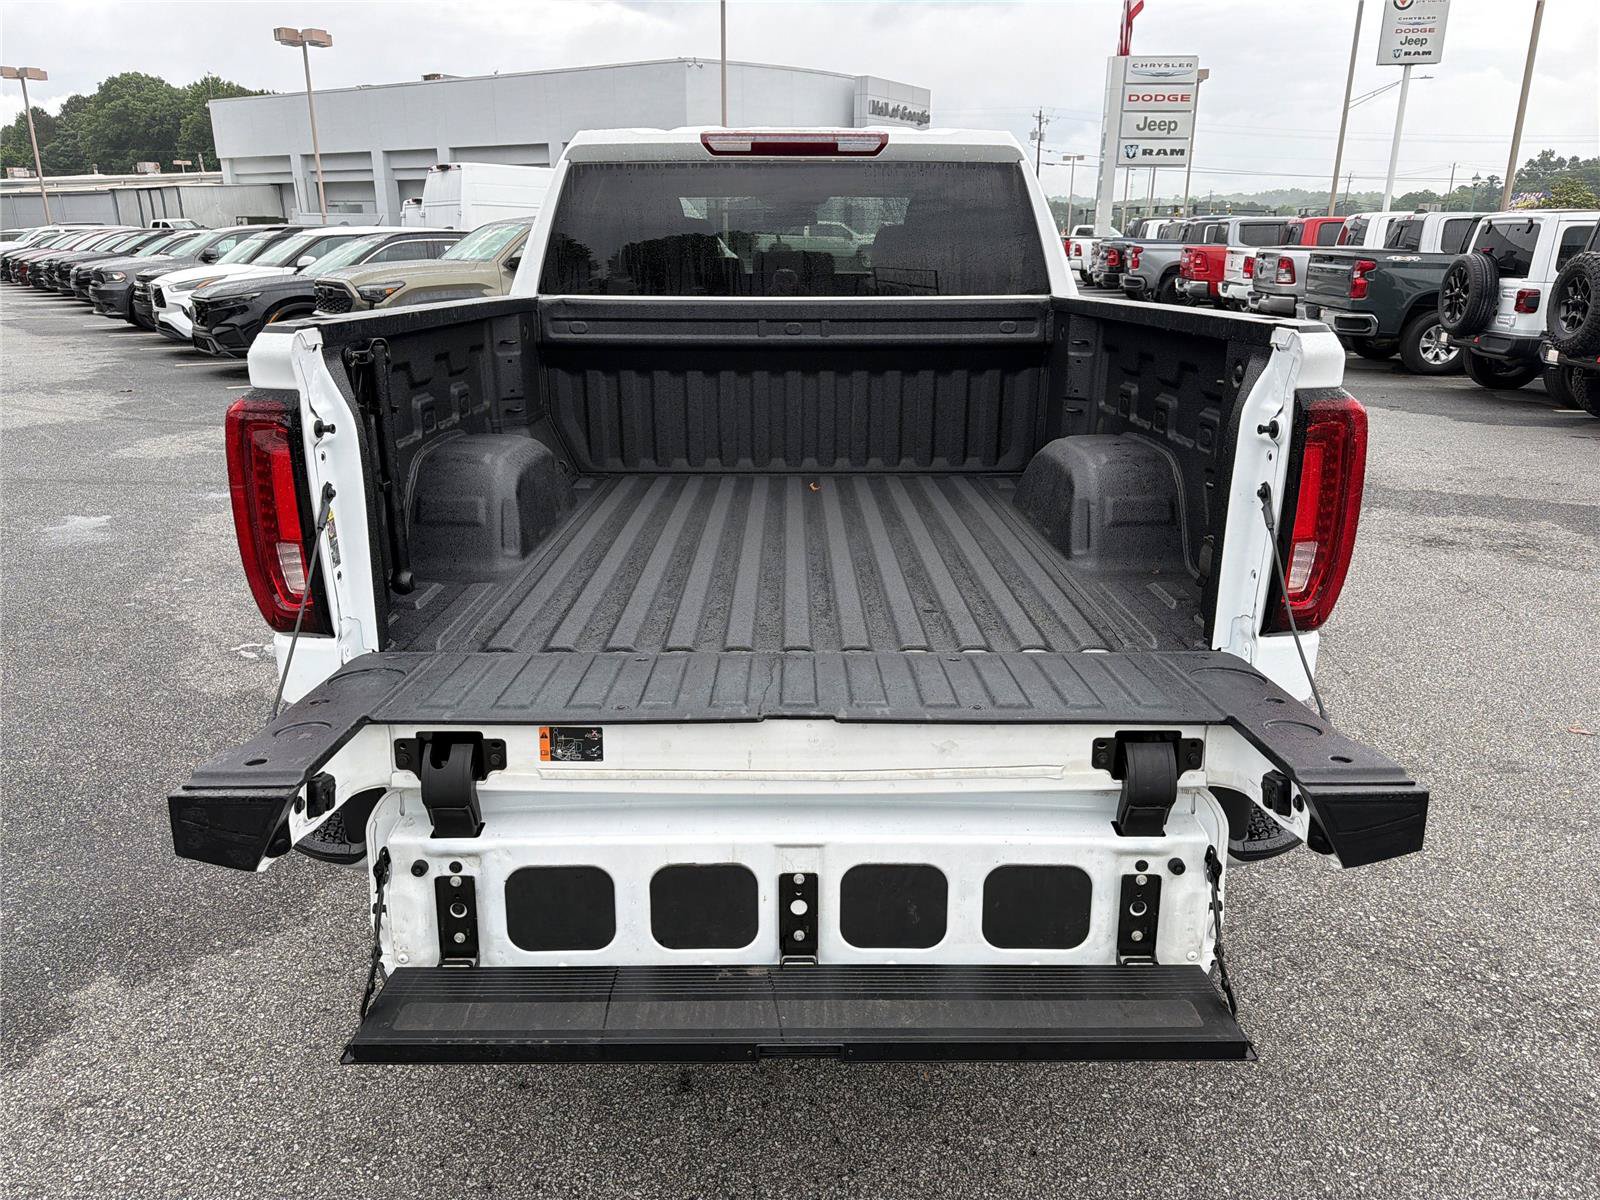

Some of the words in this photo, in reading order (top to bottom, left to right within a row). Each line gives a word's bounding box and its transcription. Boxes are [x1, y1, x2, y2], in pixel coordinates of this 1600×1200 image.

[1399, 36, 1428, 47] Jeep
[1128, 94, 1191, 102] DODGE
[1135, 116, 1178, 135] Jeep
[1141, 148, 1185, 156] RAM
